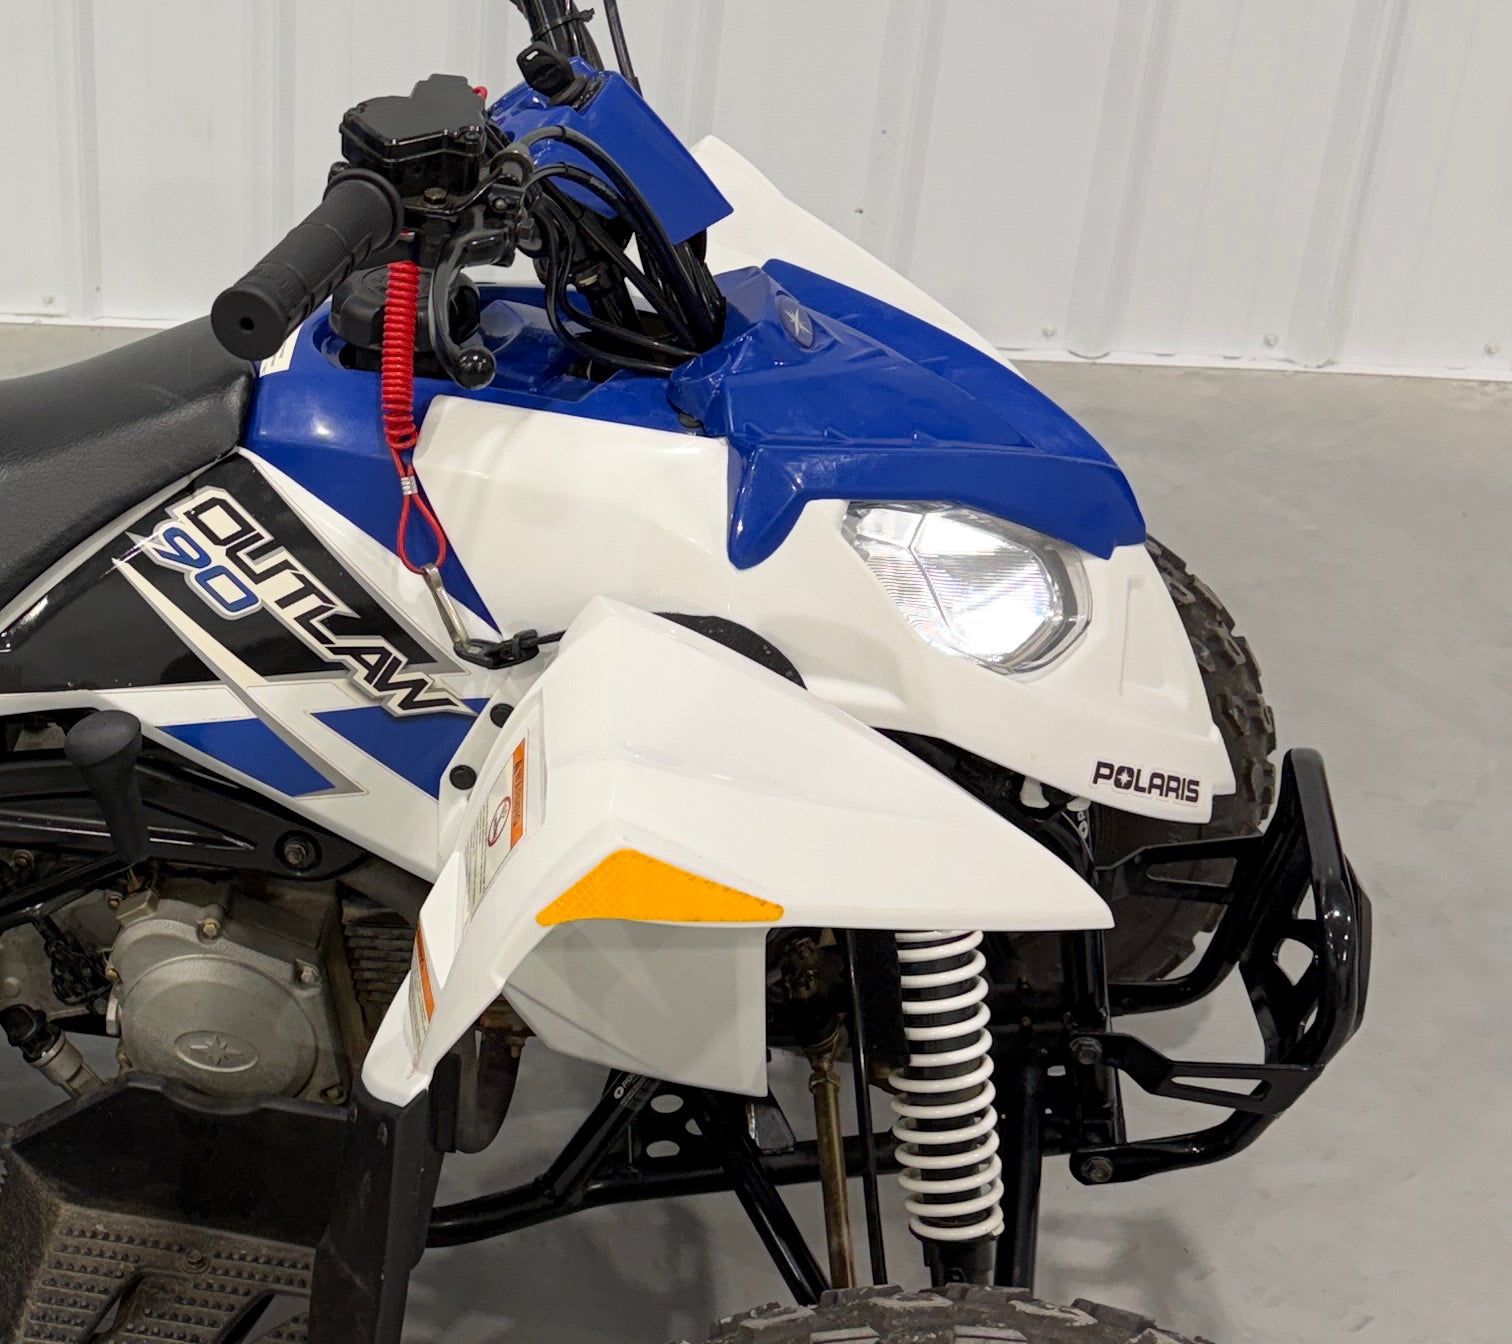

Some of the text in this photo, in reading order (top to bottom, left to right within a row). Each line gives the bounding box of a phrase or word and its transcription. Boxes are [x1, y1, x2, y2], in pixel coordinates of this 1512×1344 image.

[156, 525, 260, 615] 90
[181, 494, 464, 713] OUTLAW
[1091, 760, 1201, 804] POLARIS
